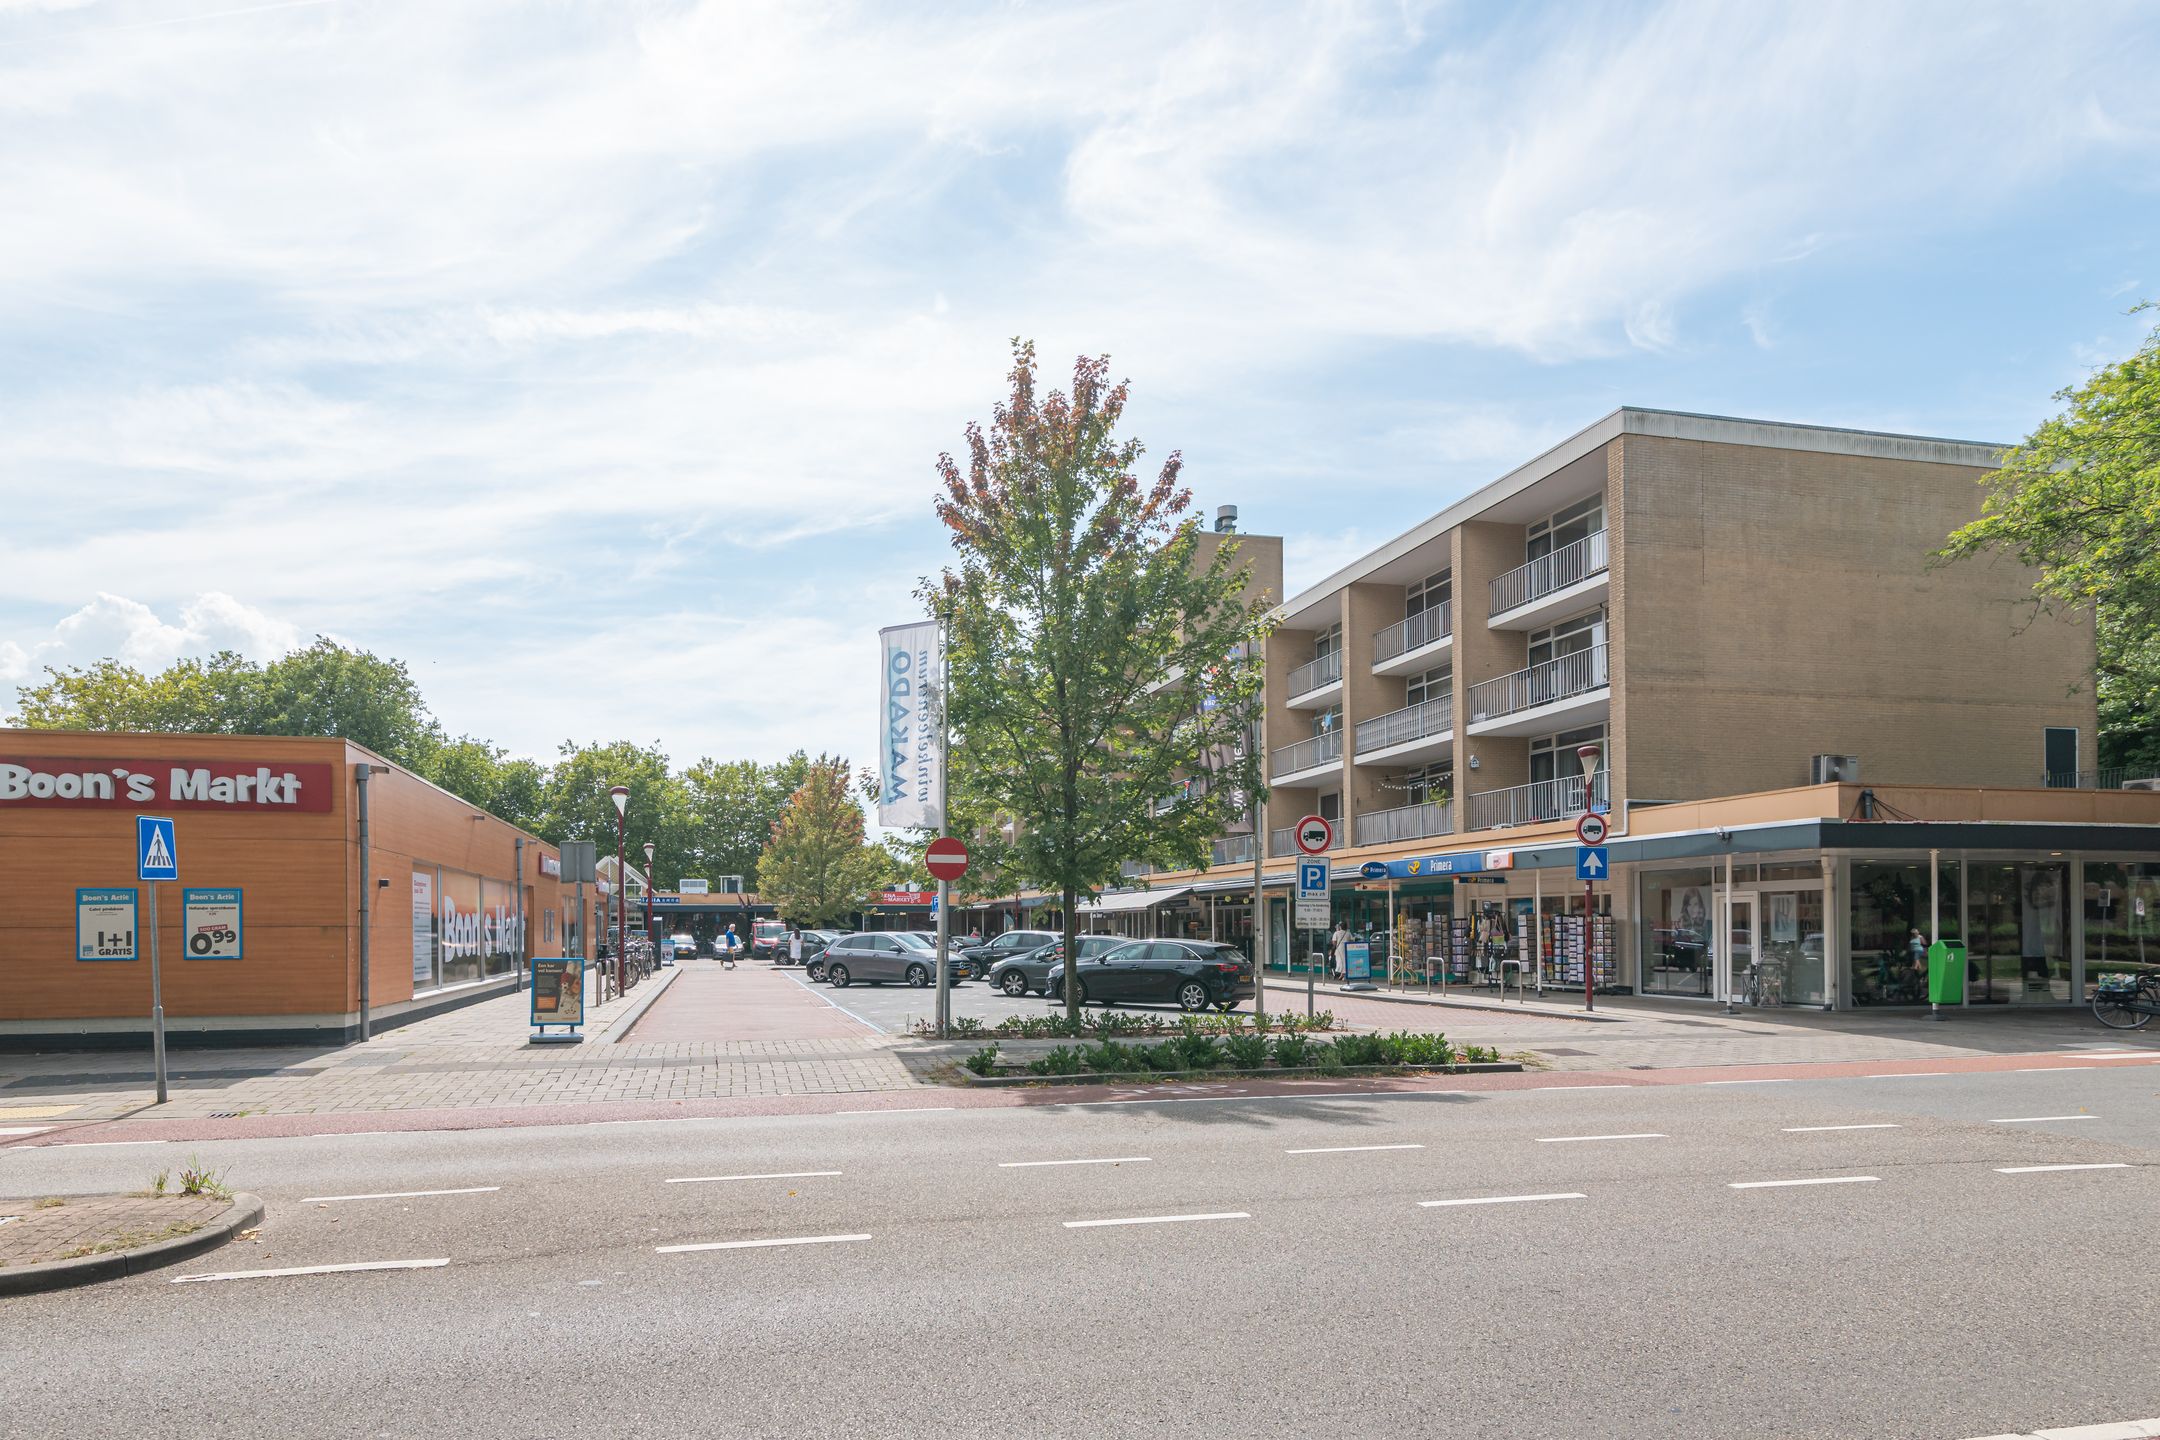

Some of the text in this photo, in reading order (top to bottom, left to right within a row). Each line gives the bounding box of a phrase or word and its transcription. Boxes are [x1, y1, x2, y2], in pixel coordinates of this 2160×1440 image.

[0, 763, 302, 804] Boon's Markt
[1430, 859, 1453, 872] Primera
[1306, 867, 1321, 888] P
[82, 894, 109, 902] Boon's
[444, 895, 492, 963] Boons
[98, 948, 133, 956] GRATIS
